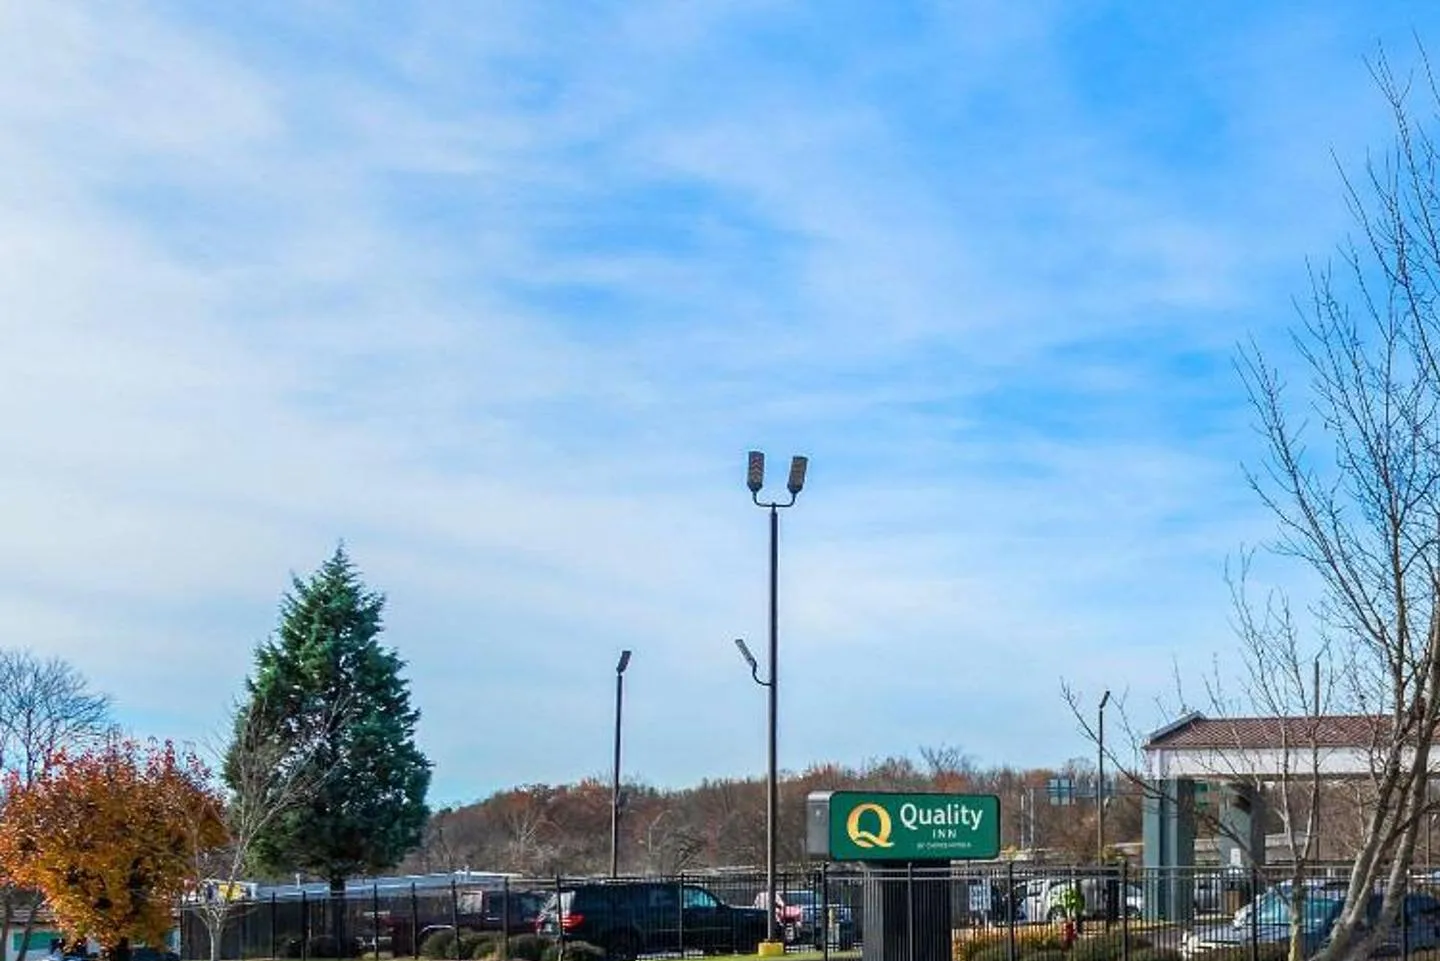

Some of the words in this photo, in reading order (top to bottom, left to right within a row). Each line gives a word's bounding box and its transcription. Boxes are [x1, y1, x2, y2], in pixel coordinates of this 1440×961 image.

[846, 803, 895, 848] Q
[900, 803, 983, 831] Quality
[932, 829, 957, 839] INN
